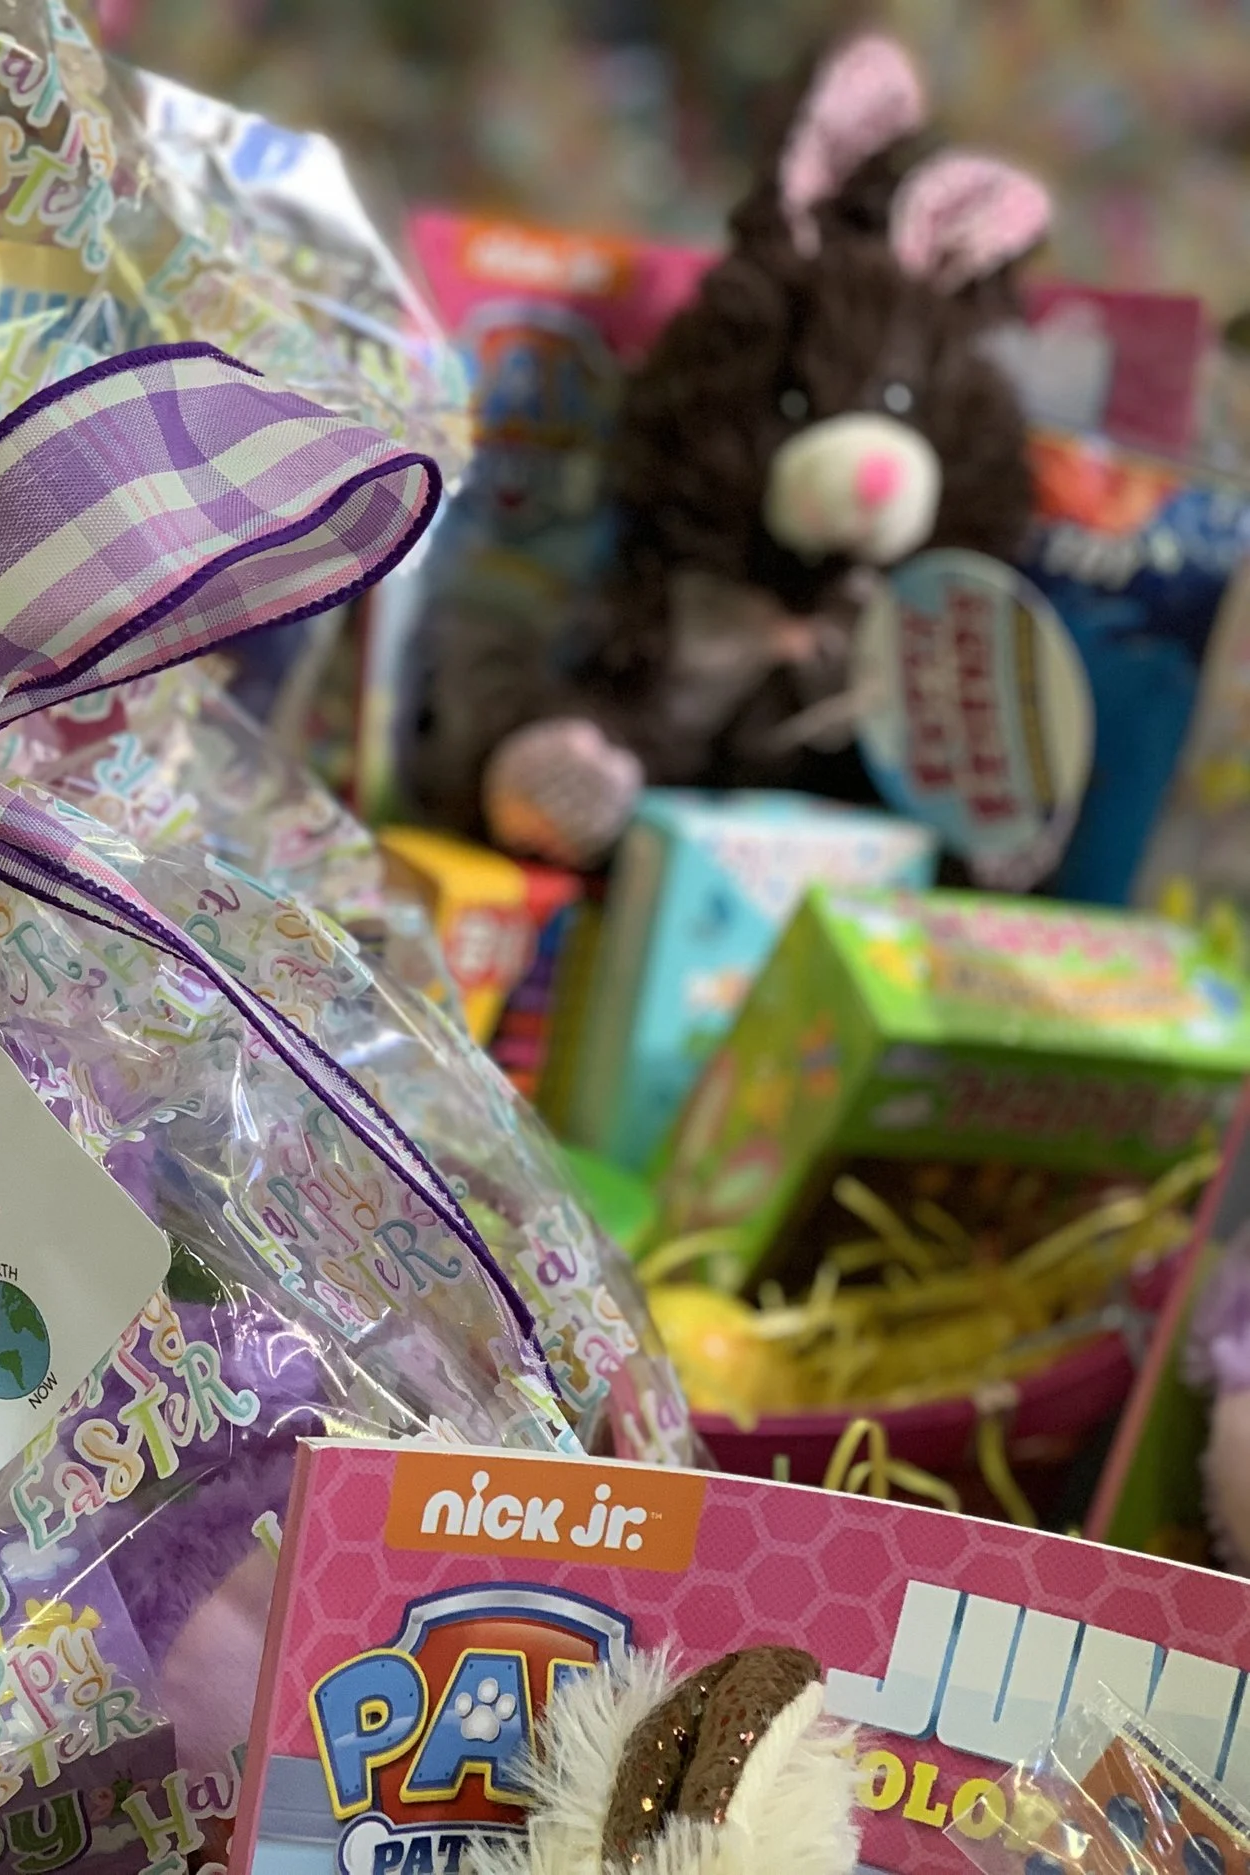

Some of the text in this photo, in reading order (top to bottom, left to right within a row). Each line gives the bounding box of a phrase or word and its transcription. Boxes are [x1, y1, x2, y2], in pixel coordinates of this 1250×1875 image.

[28, 1371, 58, 1409] NOW
[420, 1470, 565, 1543] nick
[570, 1483, 648, 1551] jr.
